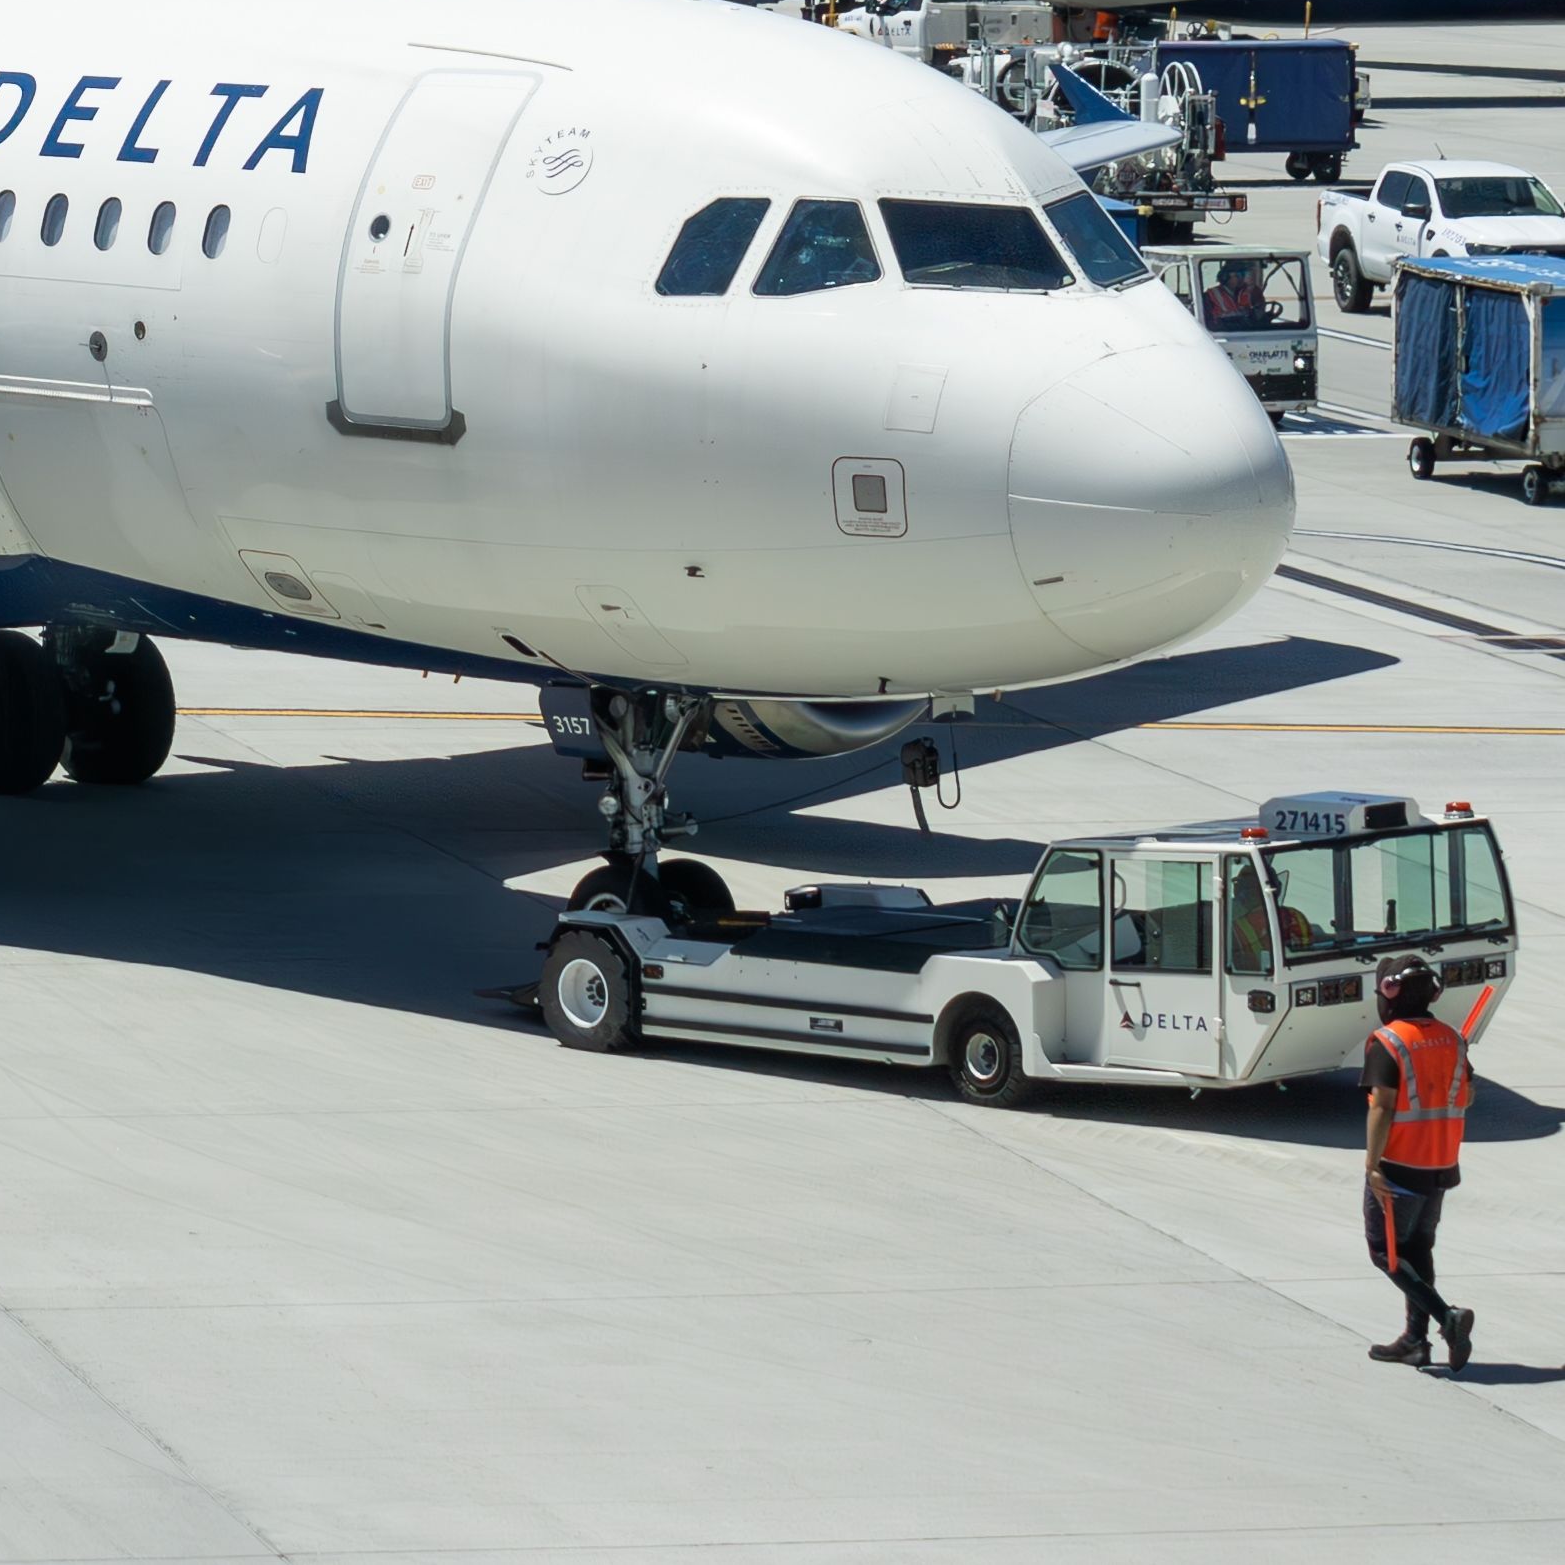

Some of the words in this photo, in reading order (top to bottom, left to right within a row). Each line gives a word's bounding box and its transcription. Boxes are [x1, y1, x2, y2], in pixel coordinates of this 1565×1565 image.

[525, 126, 591, 179] SKYTEAM
[414, 177, 433, 187] EXIT
[552, 715, 591, 735] 3157
[1275, 810, 1346, 835] 271415
[1141, 1013, 1208, 1032] DELTA
